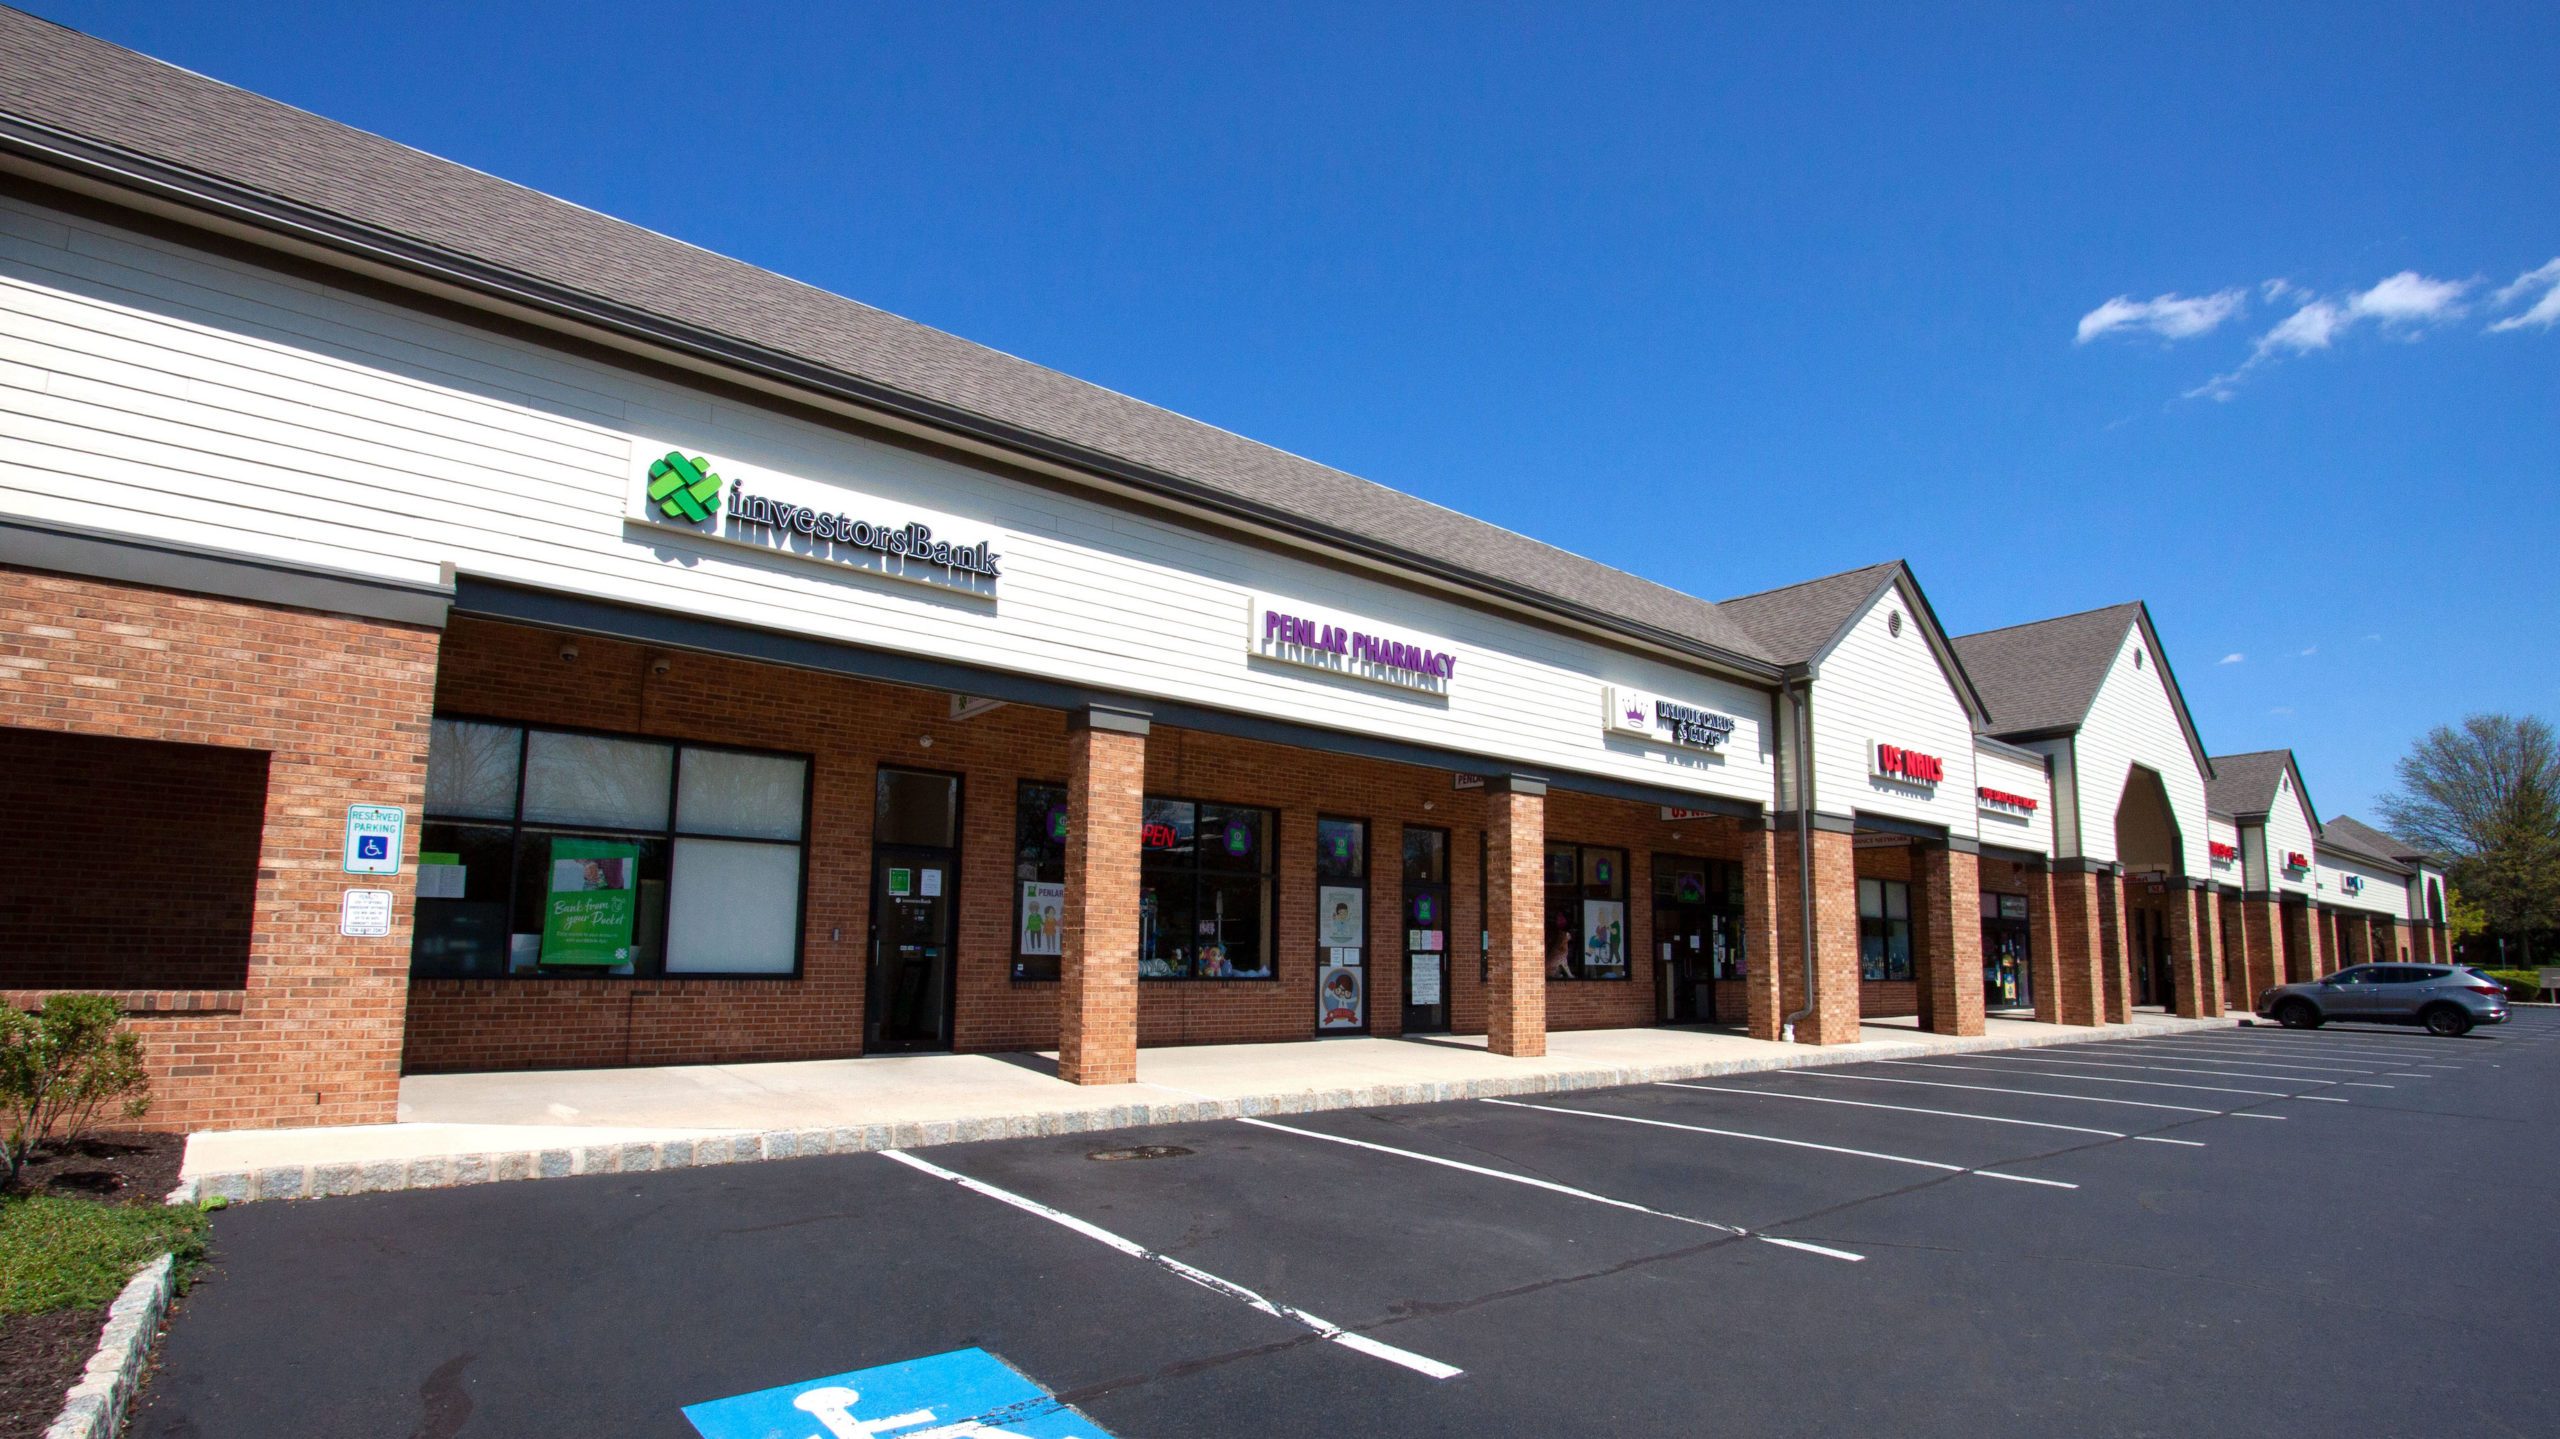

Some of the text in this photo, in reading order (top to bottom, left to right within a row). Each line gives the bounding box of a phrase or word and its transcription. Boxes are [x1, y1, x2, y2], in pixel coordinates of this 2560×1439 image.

[727, 478, 1002, 577] investorsBank
[1265, 610, 1457, 679] PENLAR PHARMACY
[1657, 700, 1736, 732] UNIQUE CARDS
[1688, 726, 1721, 746] GIFTS
[1880, 743, 1944, 782] US NAILS
[352, 810, 400, 823] RESERVED
[354, 823, 397, 834] PARKING
[1142, 823, 1176, 848] PEN
[554, 897, 609, 915] Bank from
[563, 911, 625, 931] your Pocket
